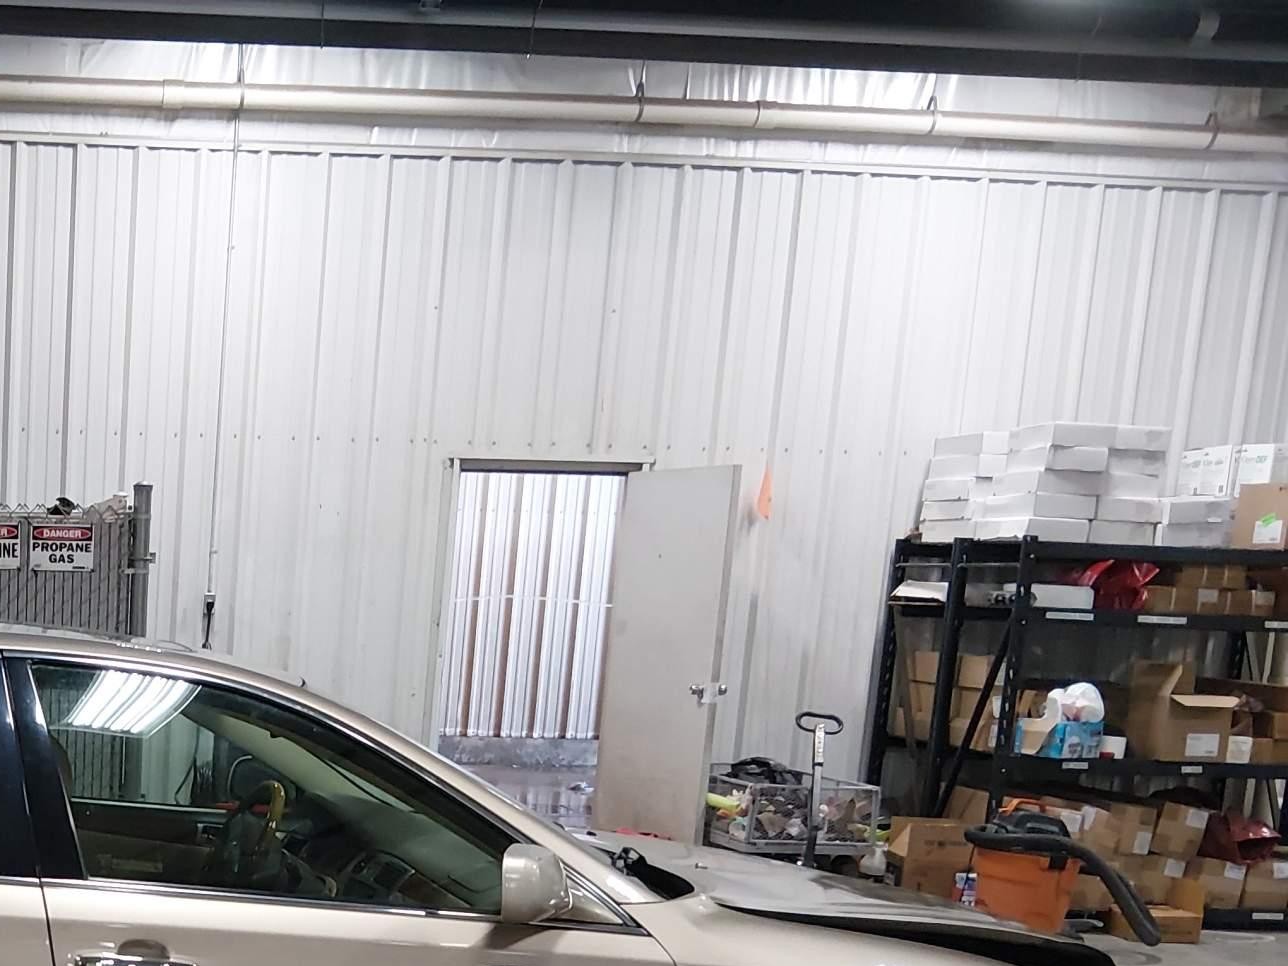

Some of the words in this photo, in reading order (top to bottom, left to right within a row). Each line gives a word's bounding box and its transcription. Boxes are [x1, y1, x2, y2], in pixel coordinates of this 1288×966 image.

[43, 529, 82, 538] DANGER
[32, 541, 92, 553] PROPANE
[48, 553, 75, 564] GAS
